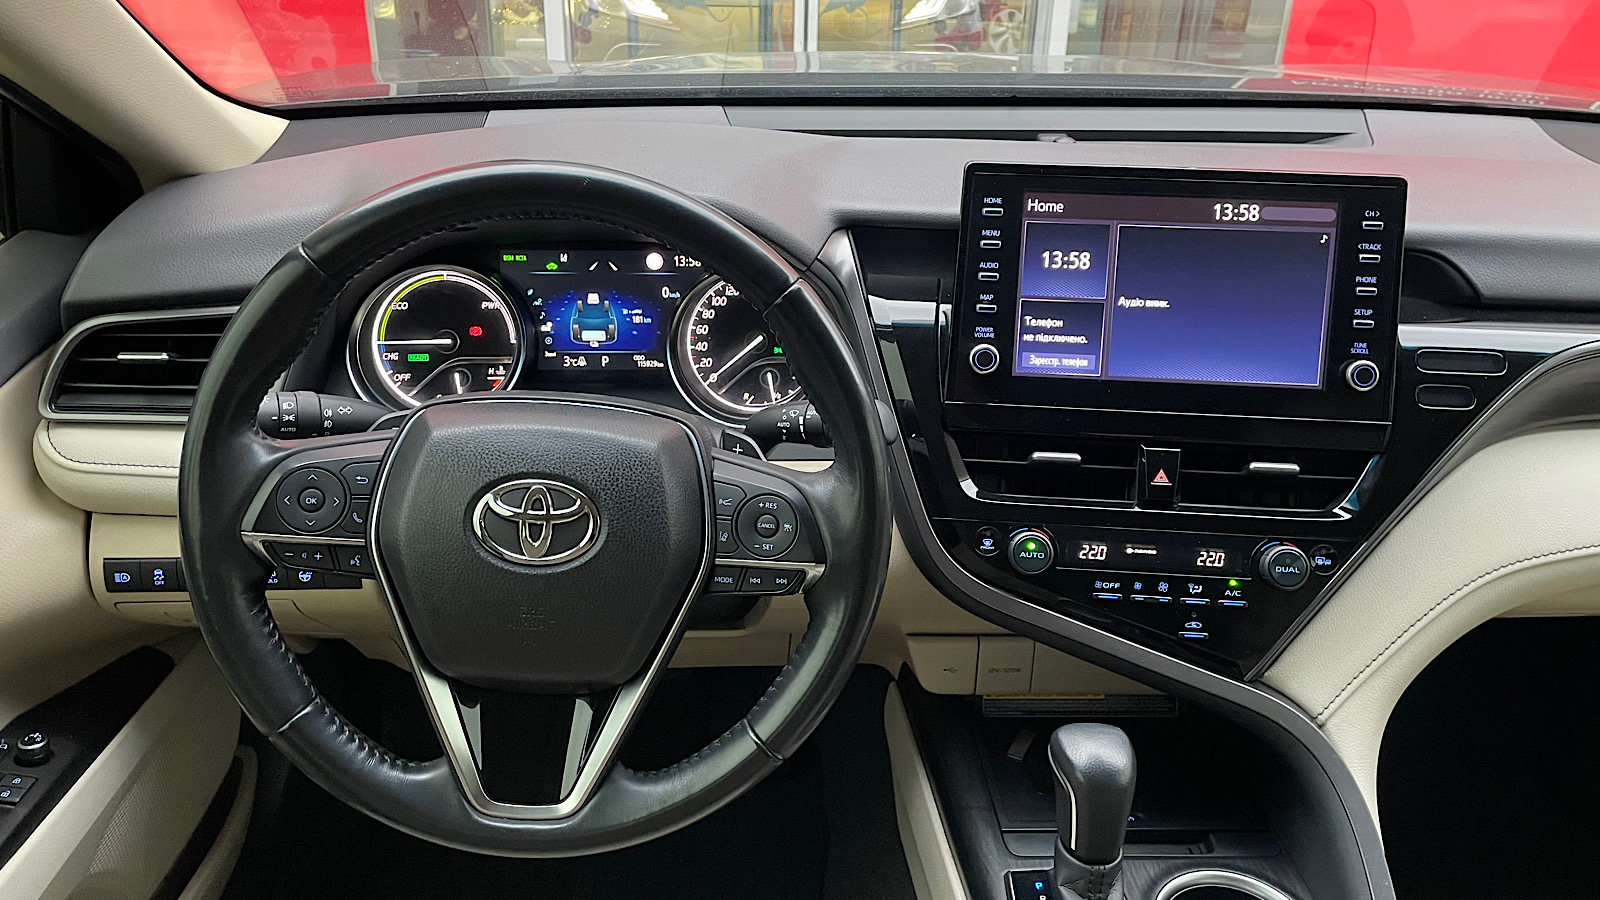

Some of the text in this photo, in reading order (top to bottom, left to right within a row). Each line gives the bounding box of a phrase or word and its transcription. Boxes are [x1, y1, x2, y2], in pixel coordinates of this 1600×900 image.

[1027, 198, 1065, 213] Home
[1213, 203, 1261, 222] 13:58
[981, 229, 1000, 237] MENU
[1042, 250, 1091, 270] 13:58
[1355, 276, 1378, 284] PHONE
[661, 286, 670, 299] 0
[980, 293, 994, 301] MAP
[391, 301, 409, 311] ECO
[481, 301, 501, 311] PWR
[711, 296, 727, 306] 100
[1117, 296, 1145, 309] Аудіо
[701, 308, 716, 319] 80
[1354, 308, 1373, 316] SETUP
[632, 315, 652, 324] 181 km
[1023, 315, 1064, 329] Телефон
[695, 324, 709, 335] 60
[1023, 332, 1089, 344] не підключено.
[694, 341, 709, 352] 40
[382, 352, 399, 361] CHG
[601, 355, 610, 367] P
[699, 357, 713, 368] 20
[393, 373, 412, 383] OFF
[305, 496, 317, 505] OK
[1019, 551, 1045, 559] AUTO
[1275, 565, 1300, 574] DUAL
[714, 576, 734, 584] MODE
[1102, 581, 1121, 589] OFF
[1224, 589, 1242, 597] A/C
[1034, 881, 1043, 890] P
